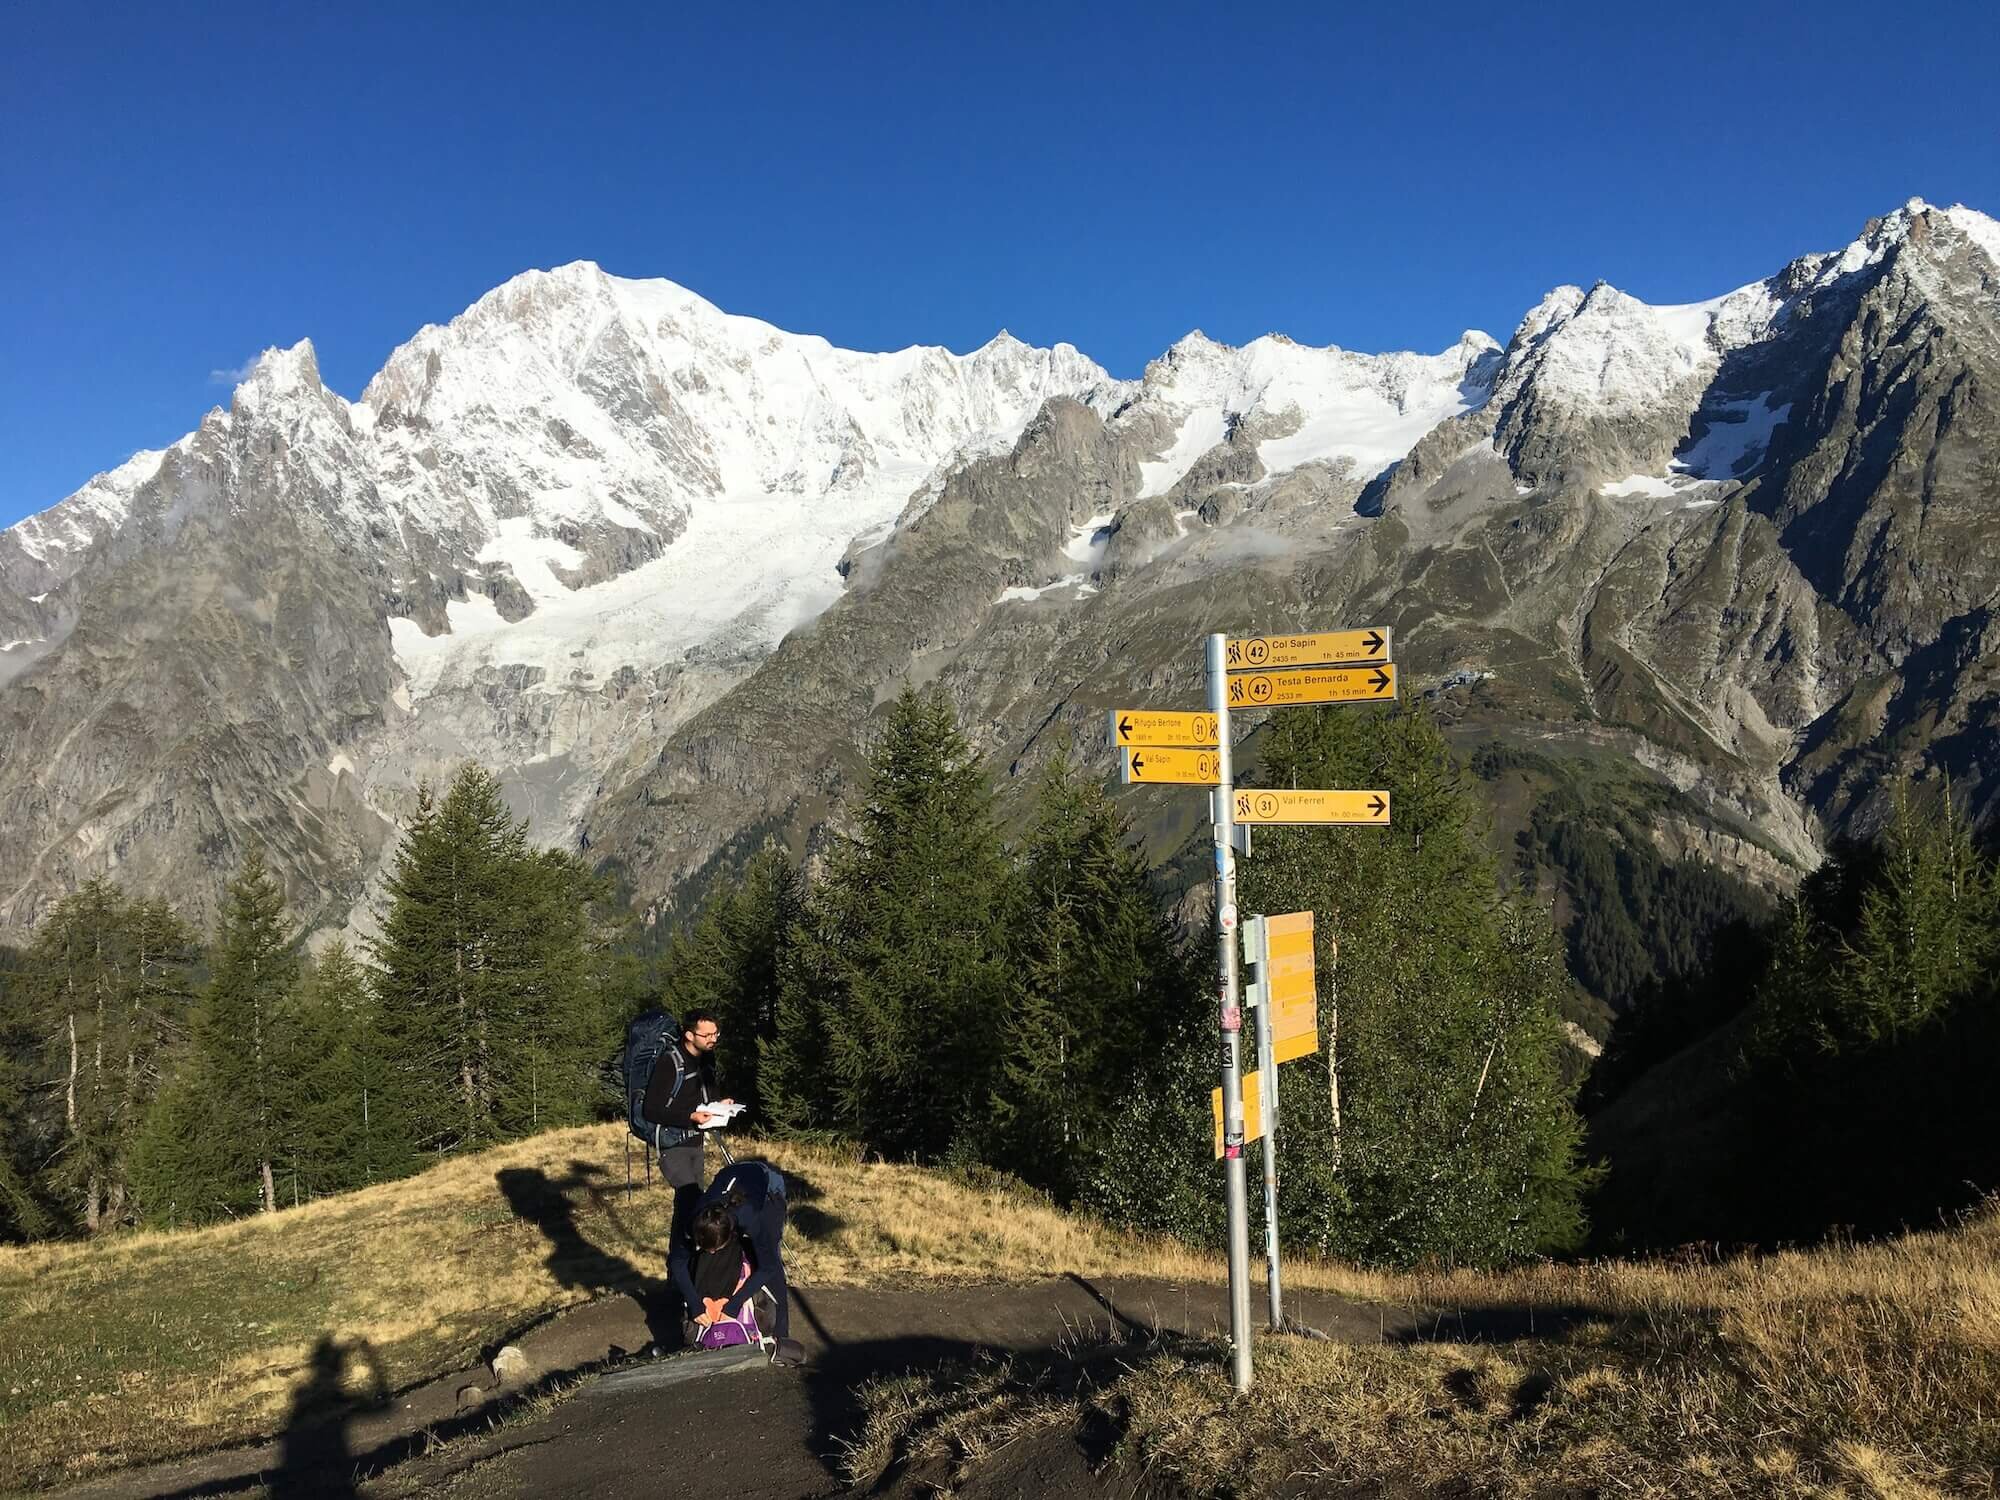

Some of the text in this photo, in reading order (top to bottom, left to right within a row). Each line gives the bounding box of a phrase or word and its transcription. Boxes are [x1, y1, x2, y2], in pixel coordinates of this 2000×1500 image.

[1272, 639, 1316, 650] Col Sapin
[1250, 646, 1264, 657] 42
[1322, 652, 1332, 660] 1h
[1335, 651, 1344, 659] 45
[1272, 655, 1289, 663] 2435
[1277, 674, 1349, 686] Testa Bernarda
[1254, 684, 1267, 695] 42
[1352, 687, 1366, 696] min
[1196, 724, 1203, 735] 31
[1145, 754, 1171, 765] Val Sapin
[1199, 762, 1207, 773] 42
[1261, 801, 1272, 811] 31
[1282, 796, 1325, 805] Val Ferret
